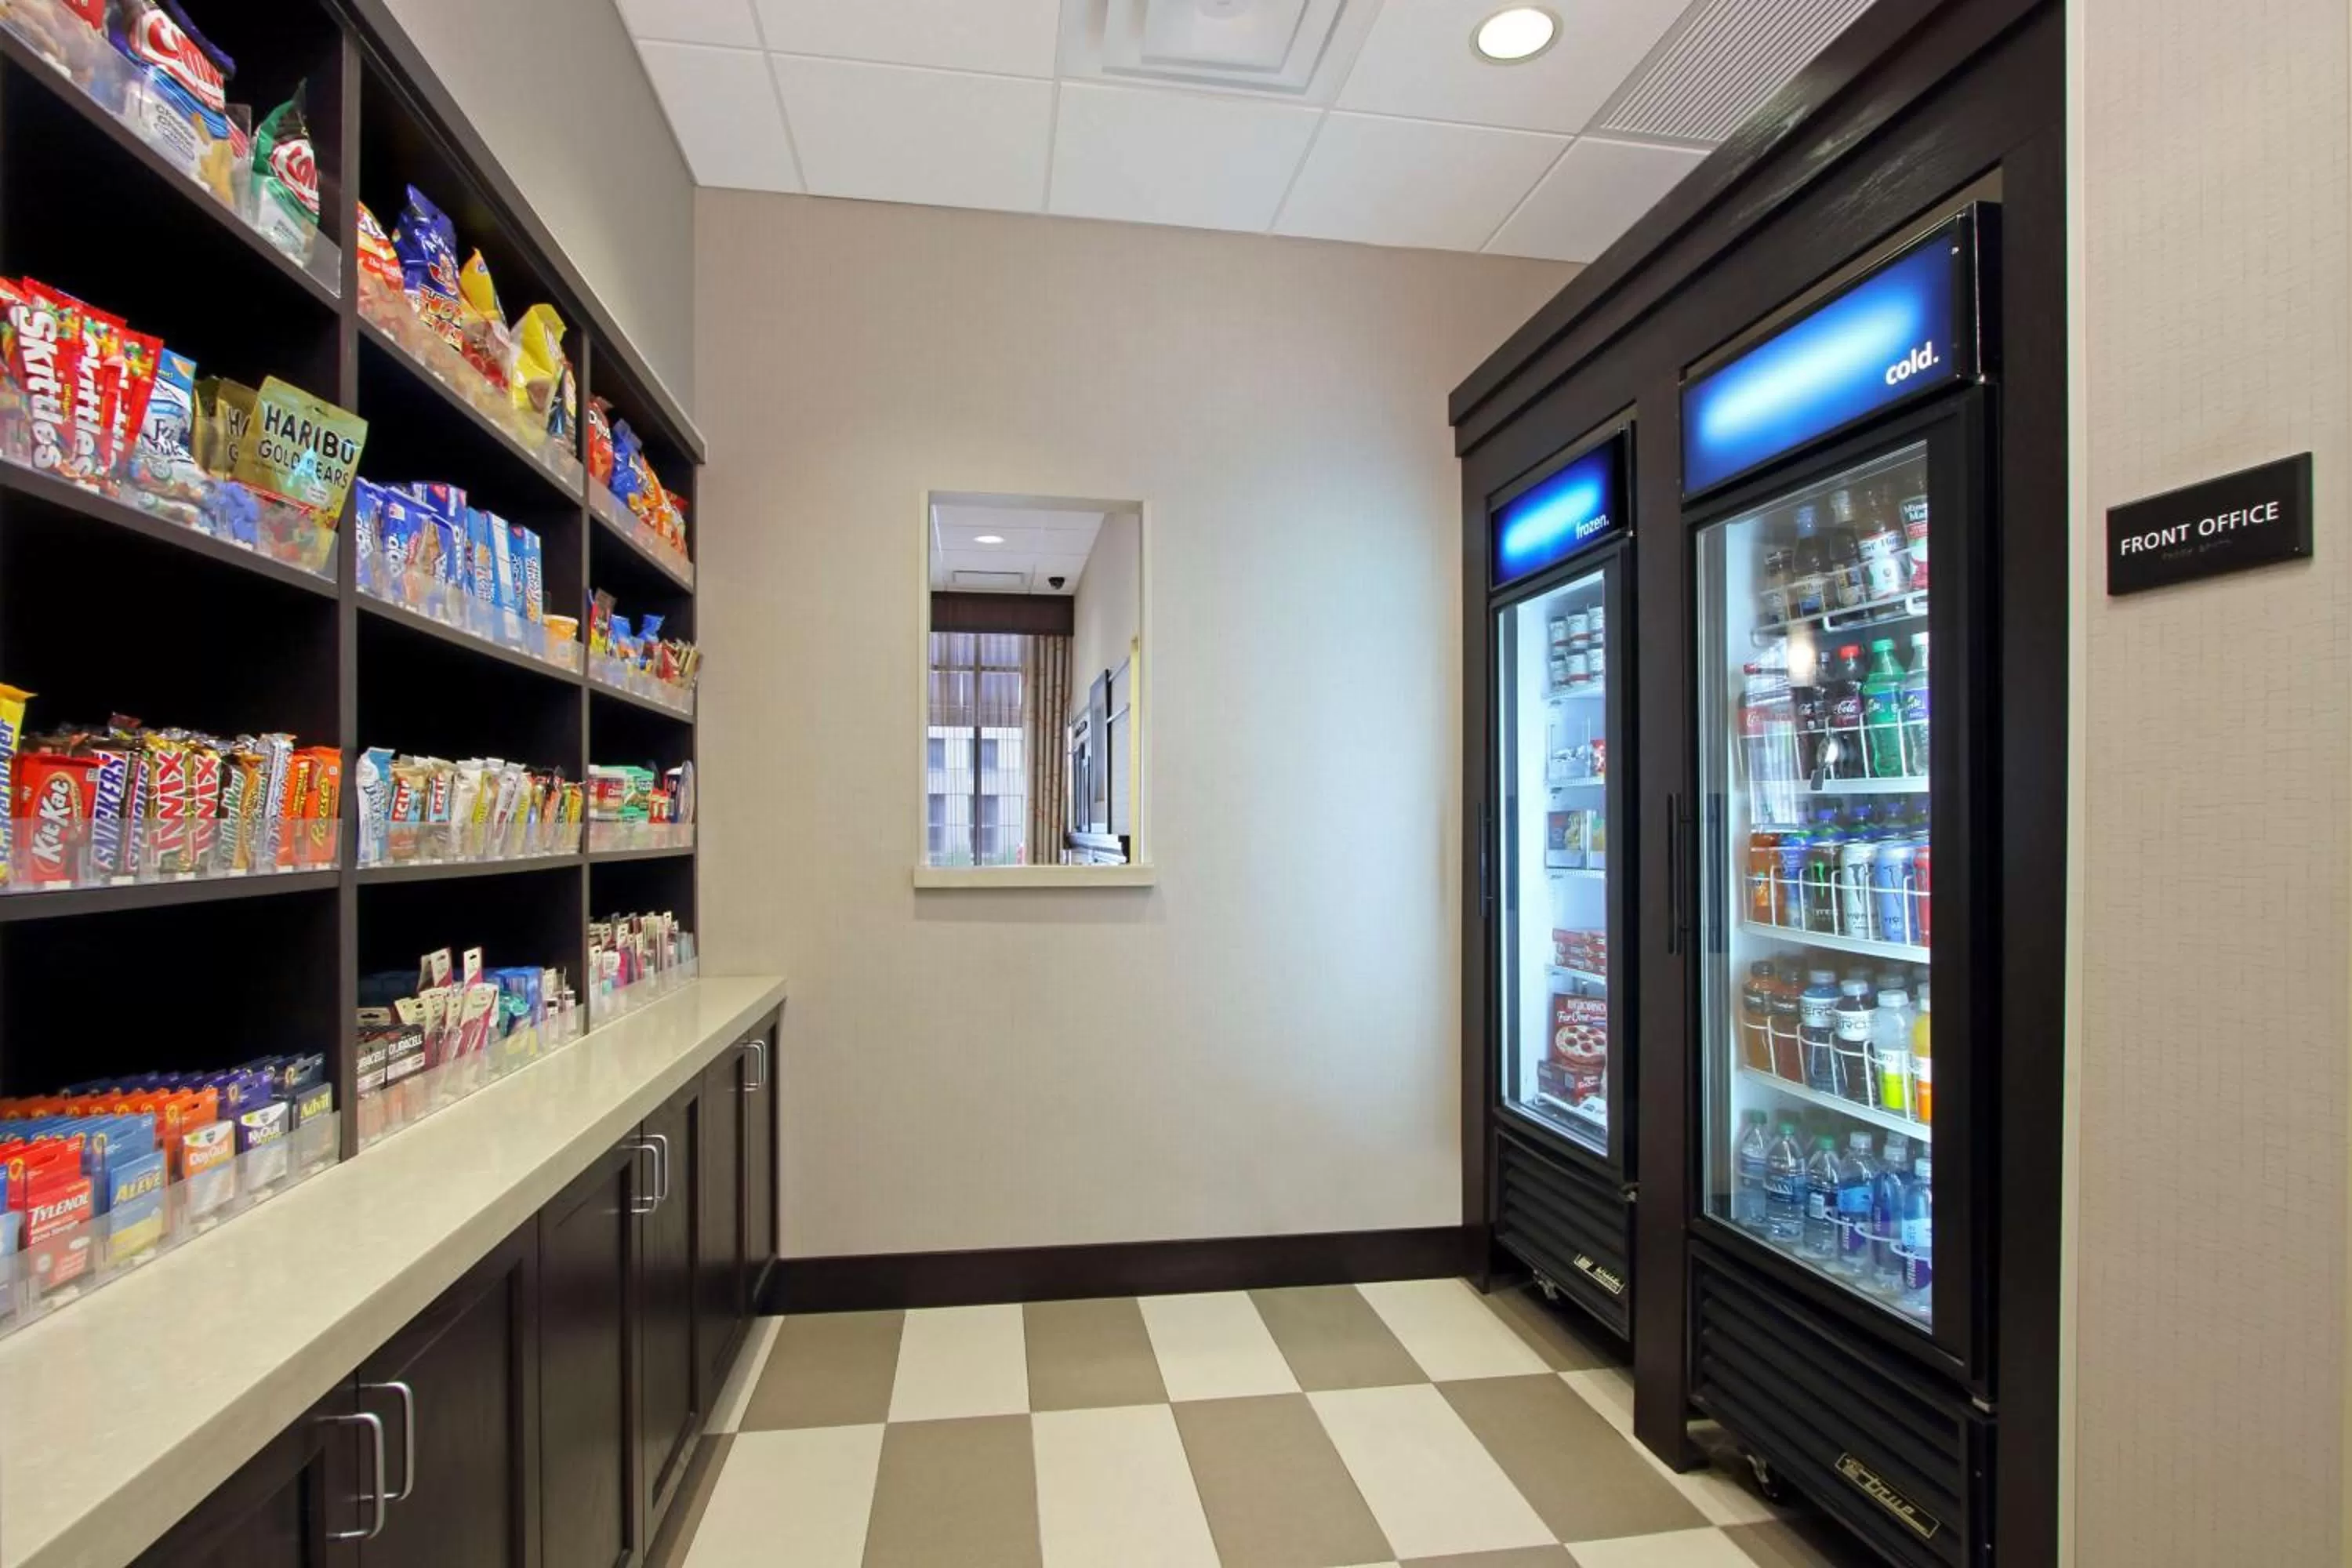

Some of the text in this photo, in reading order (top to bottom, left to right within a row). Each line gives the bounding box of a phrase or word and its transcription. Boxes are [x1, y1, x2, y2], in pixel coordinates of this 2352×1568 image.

[19, 304, 63, 469] Skittles
[1886, 340, 1939, 385] cold.
[258, 438, 301, 470] GOLD
[264, 403, 355, 465] HARIBO
[1576, 514, 1610, 540] frozen.
[2121, 501, 2280, 556] FRONT OFFICE
[92, 757, 126, 867] SNICKERS
[151, 750, 185, 866] TWIX
[190, 755, 220, 864] TWIX
[28, 1192, 89, 1228] TYLENOL
